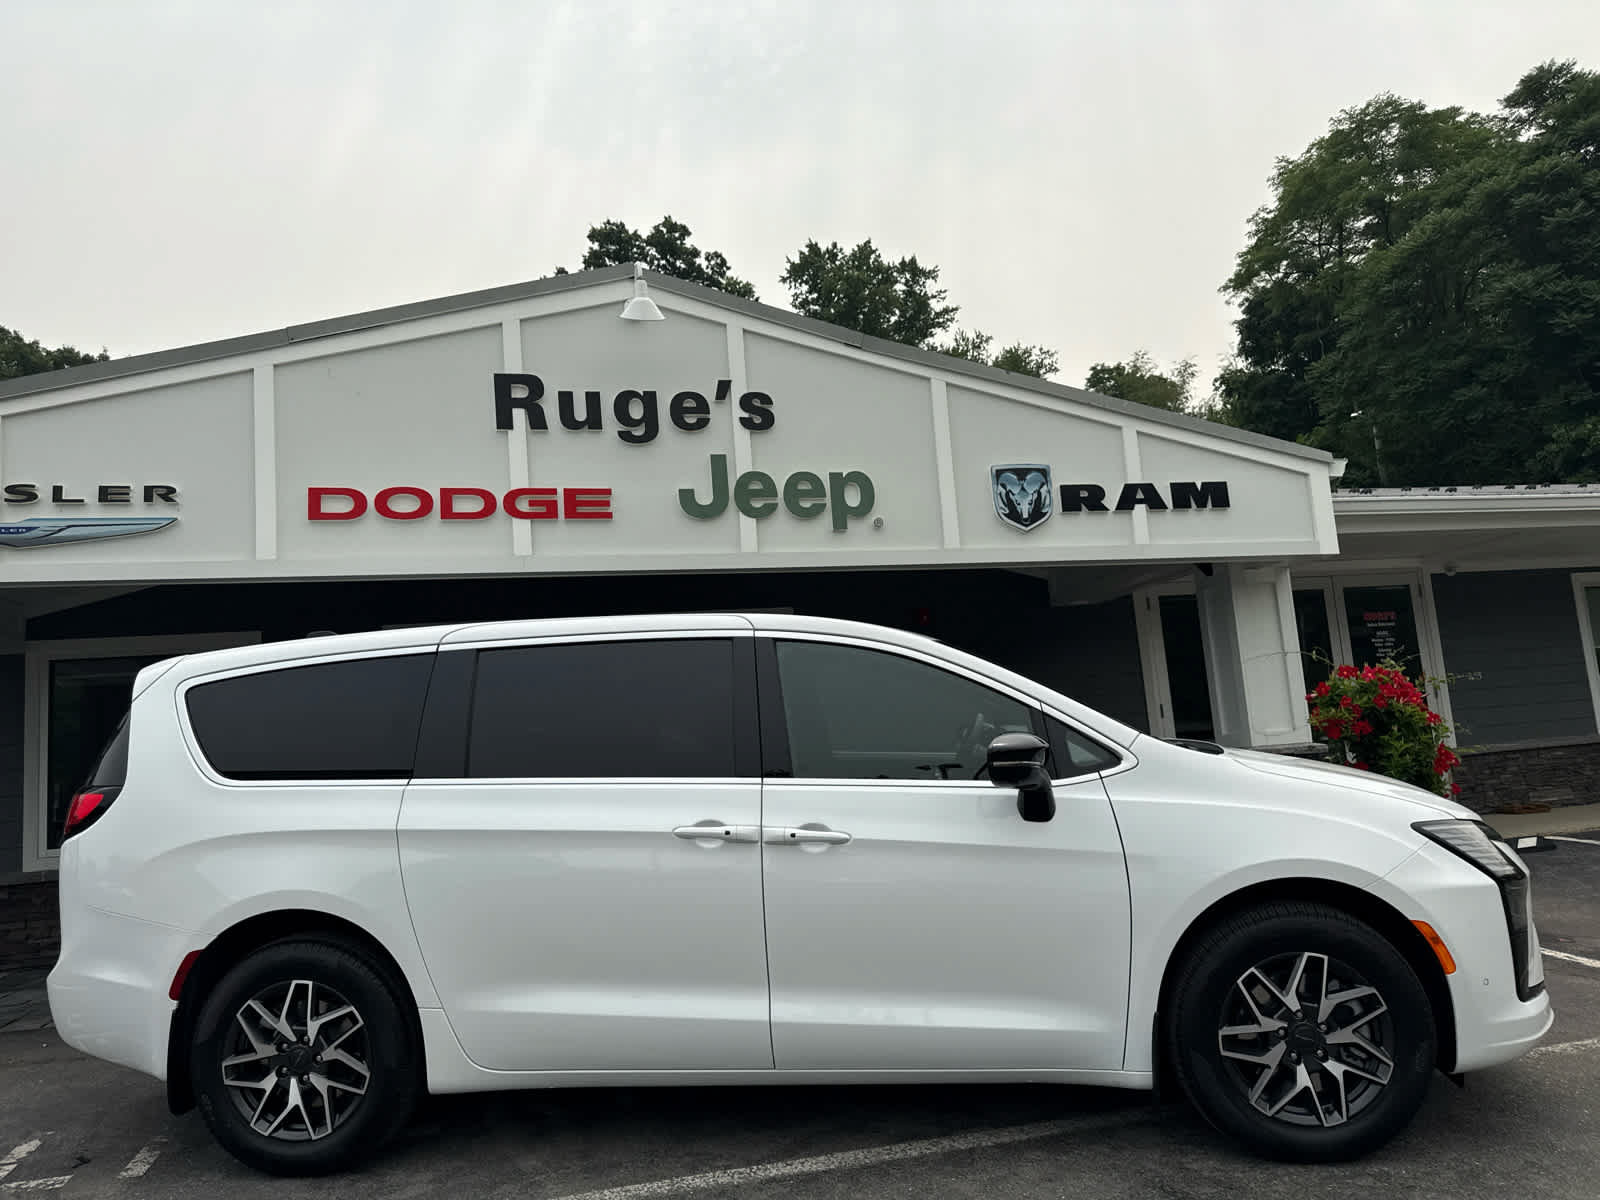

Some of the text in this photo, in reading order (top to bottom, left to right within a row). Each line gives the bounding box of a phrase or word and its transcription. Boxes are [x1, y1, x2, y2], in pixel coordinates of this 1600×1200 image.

[494, 373, 775, 444] Ruge's
[4, 484, 177, 503] SLER
[307, 486, 613, 521] DODGE
[1059, 481, 1231, 512] RAM
